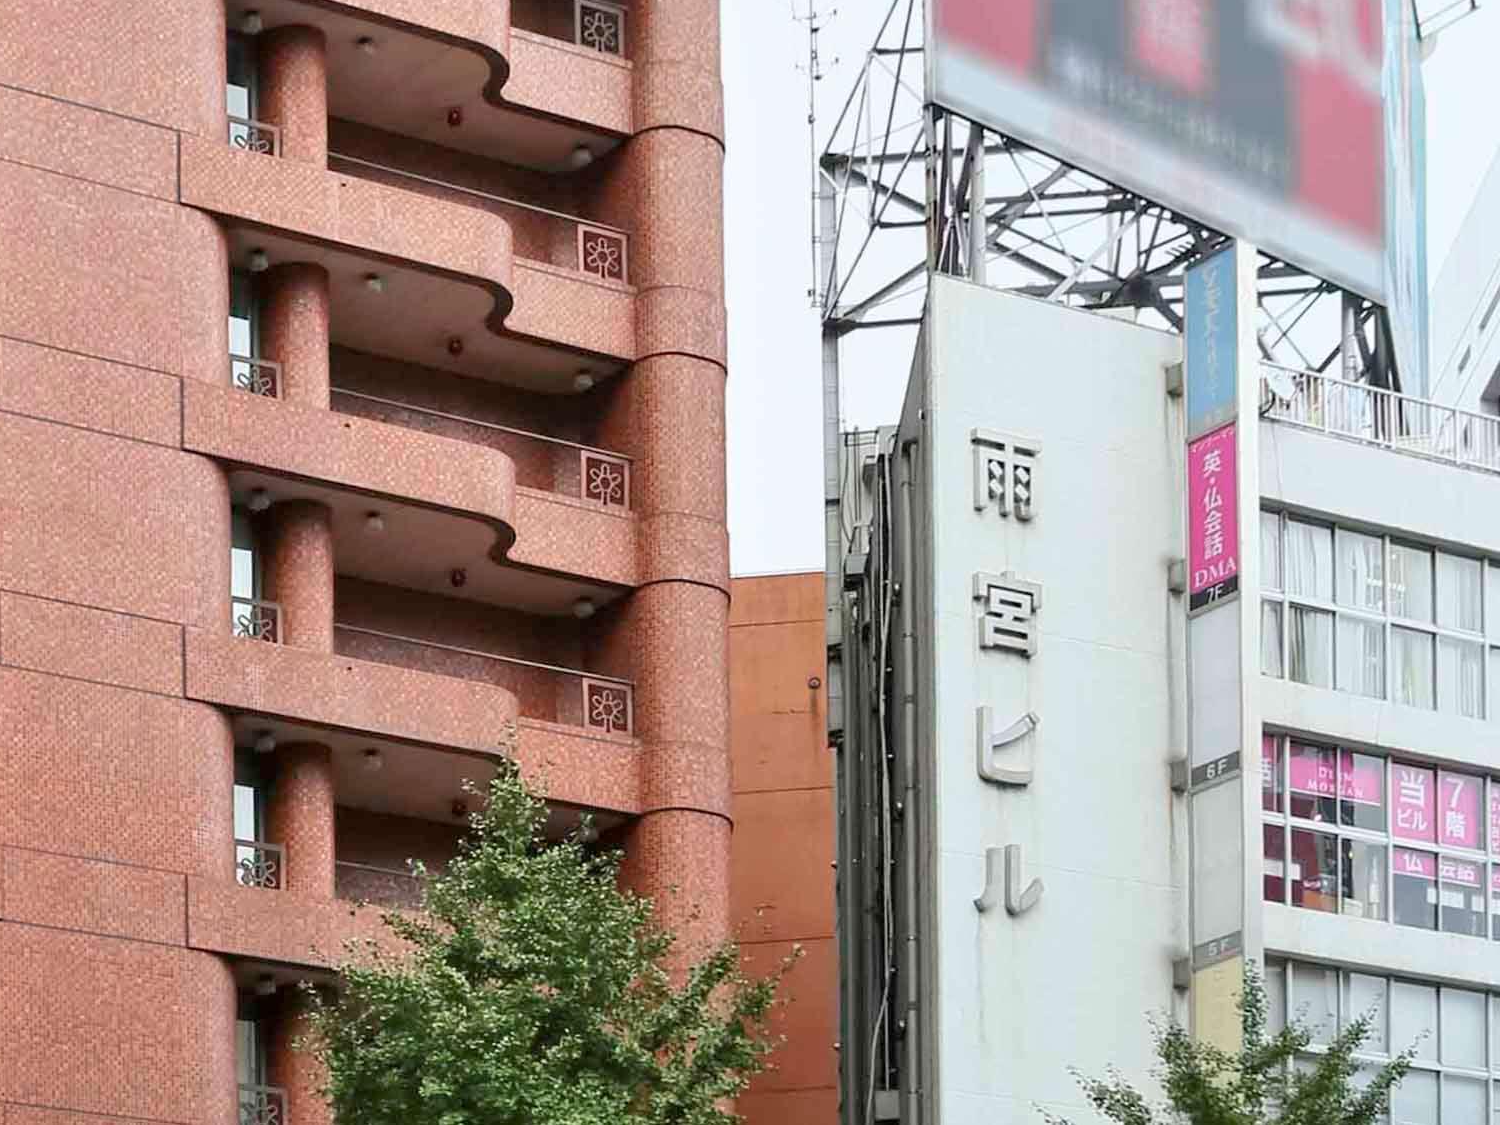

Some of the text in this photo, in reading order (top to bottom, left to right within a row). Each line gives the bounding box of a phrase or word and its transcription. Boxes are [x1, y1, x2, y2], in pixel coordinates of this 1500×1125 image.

[1203, 448, 1222, 561] 英・仏会話
[1194, 556, 1237, 588] DMA
[1206, 582, 1225, 605] 7F
[970, 426, 1044, 917] 雨宮ビル
[1206, 758, 1228, 779] 6F
[1307, 778, 1364, 798] MORAN
[1207, 939, 1229, 957] 5F
